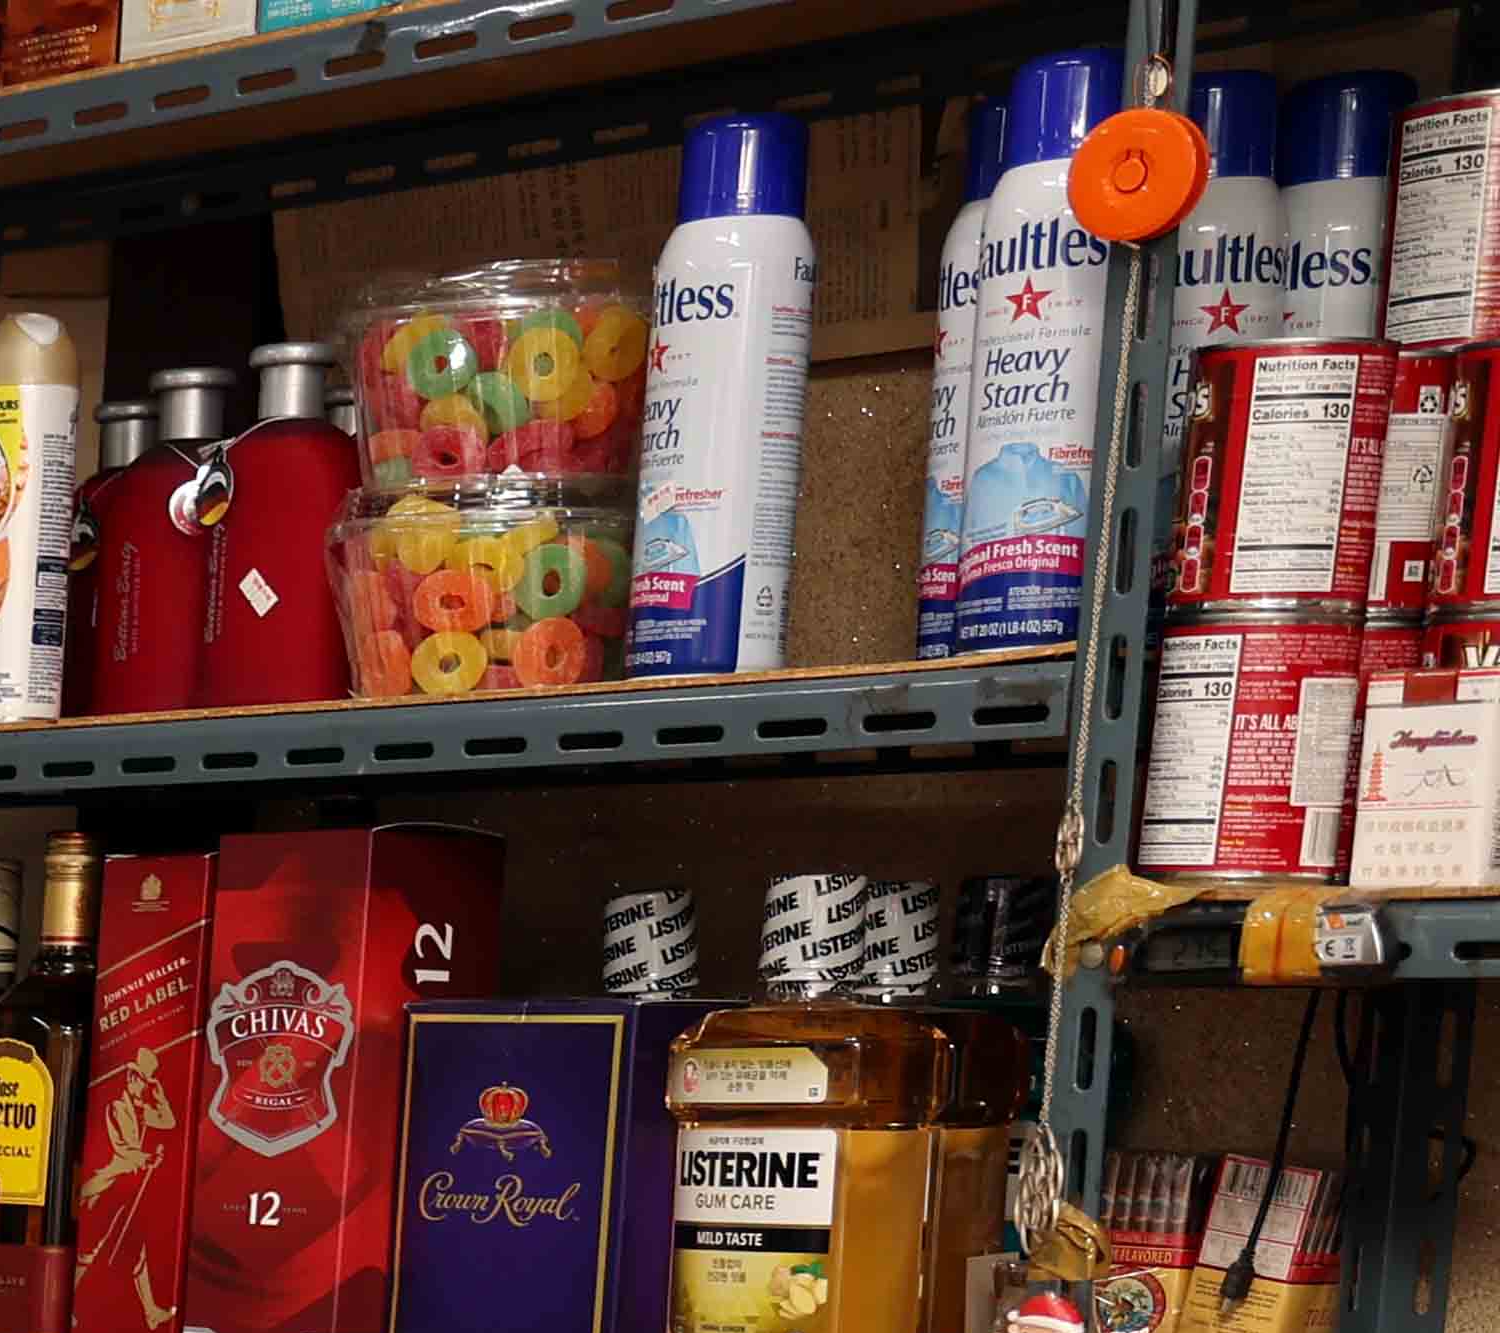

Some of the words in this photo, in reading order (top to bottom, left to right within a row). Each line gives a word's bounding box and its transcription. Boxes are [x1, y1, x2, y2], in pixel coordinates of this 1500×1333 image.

[1452, 110, 1490, 128] Facts
[1452, 153, 1485, 171] 130
[984, 347, 1071, 377] Heavy
[1258, 359, 1318, 373] Nutrition
[1322, 358, 1356, 371] Facts
[981, 375, 1071, 411] Starch
[1027, 407, 1076, 423] Fuerte
[1252, 407, 1309, 421] Calories
[1321, 402, 1350, 418] 130
[993, 539, 1033, 558] Fresh
[1035, 539, 1079, 558] Scent
[1015, 556, 1060, 571] Original
[1203, 637, 1238, 650] Facts
[1203, 681, 1233, 698] 130
[1259, 713, 1281, 731] ALL
[605, 900, 655, 933] TERINE
[414, 920, 455, 985] 12
[102, 975, 146, 1009] JOHNNIE
[145, 957, 191, 985] WALKER
[99, 1003, 133, 1033] RED
[135, 977, 193, 1014] LABEL
[229, 1007, 329, 1039] CHIVAS
[255, 1095, 293, 1107] REGAL
[680, 1150, 821, 1189] LISTERINE
[418, 1172, 492, 1222] Crown
[480, 1172, 580, 1225] Royal
[694, 1192, 727, 1210] GUM
[730, 1193, 776, 1212] CARE
[246, 1190, 281, 1227] 12
[696, 1230, 724, 1246] MILD
[725, 1231, 764, 1247] TASTE
